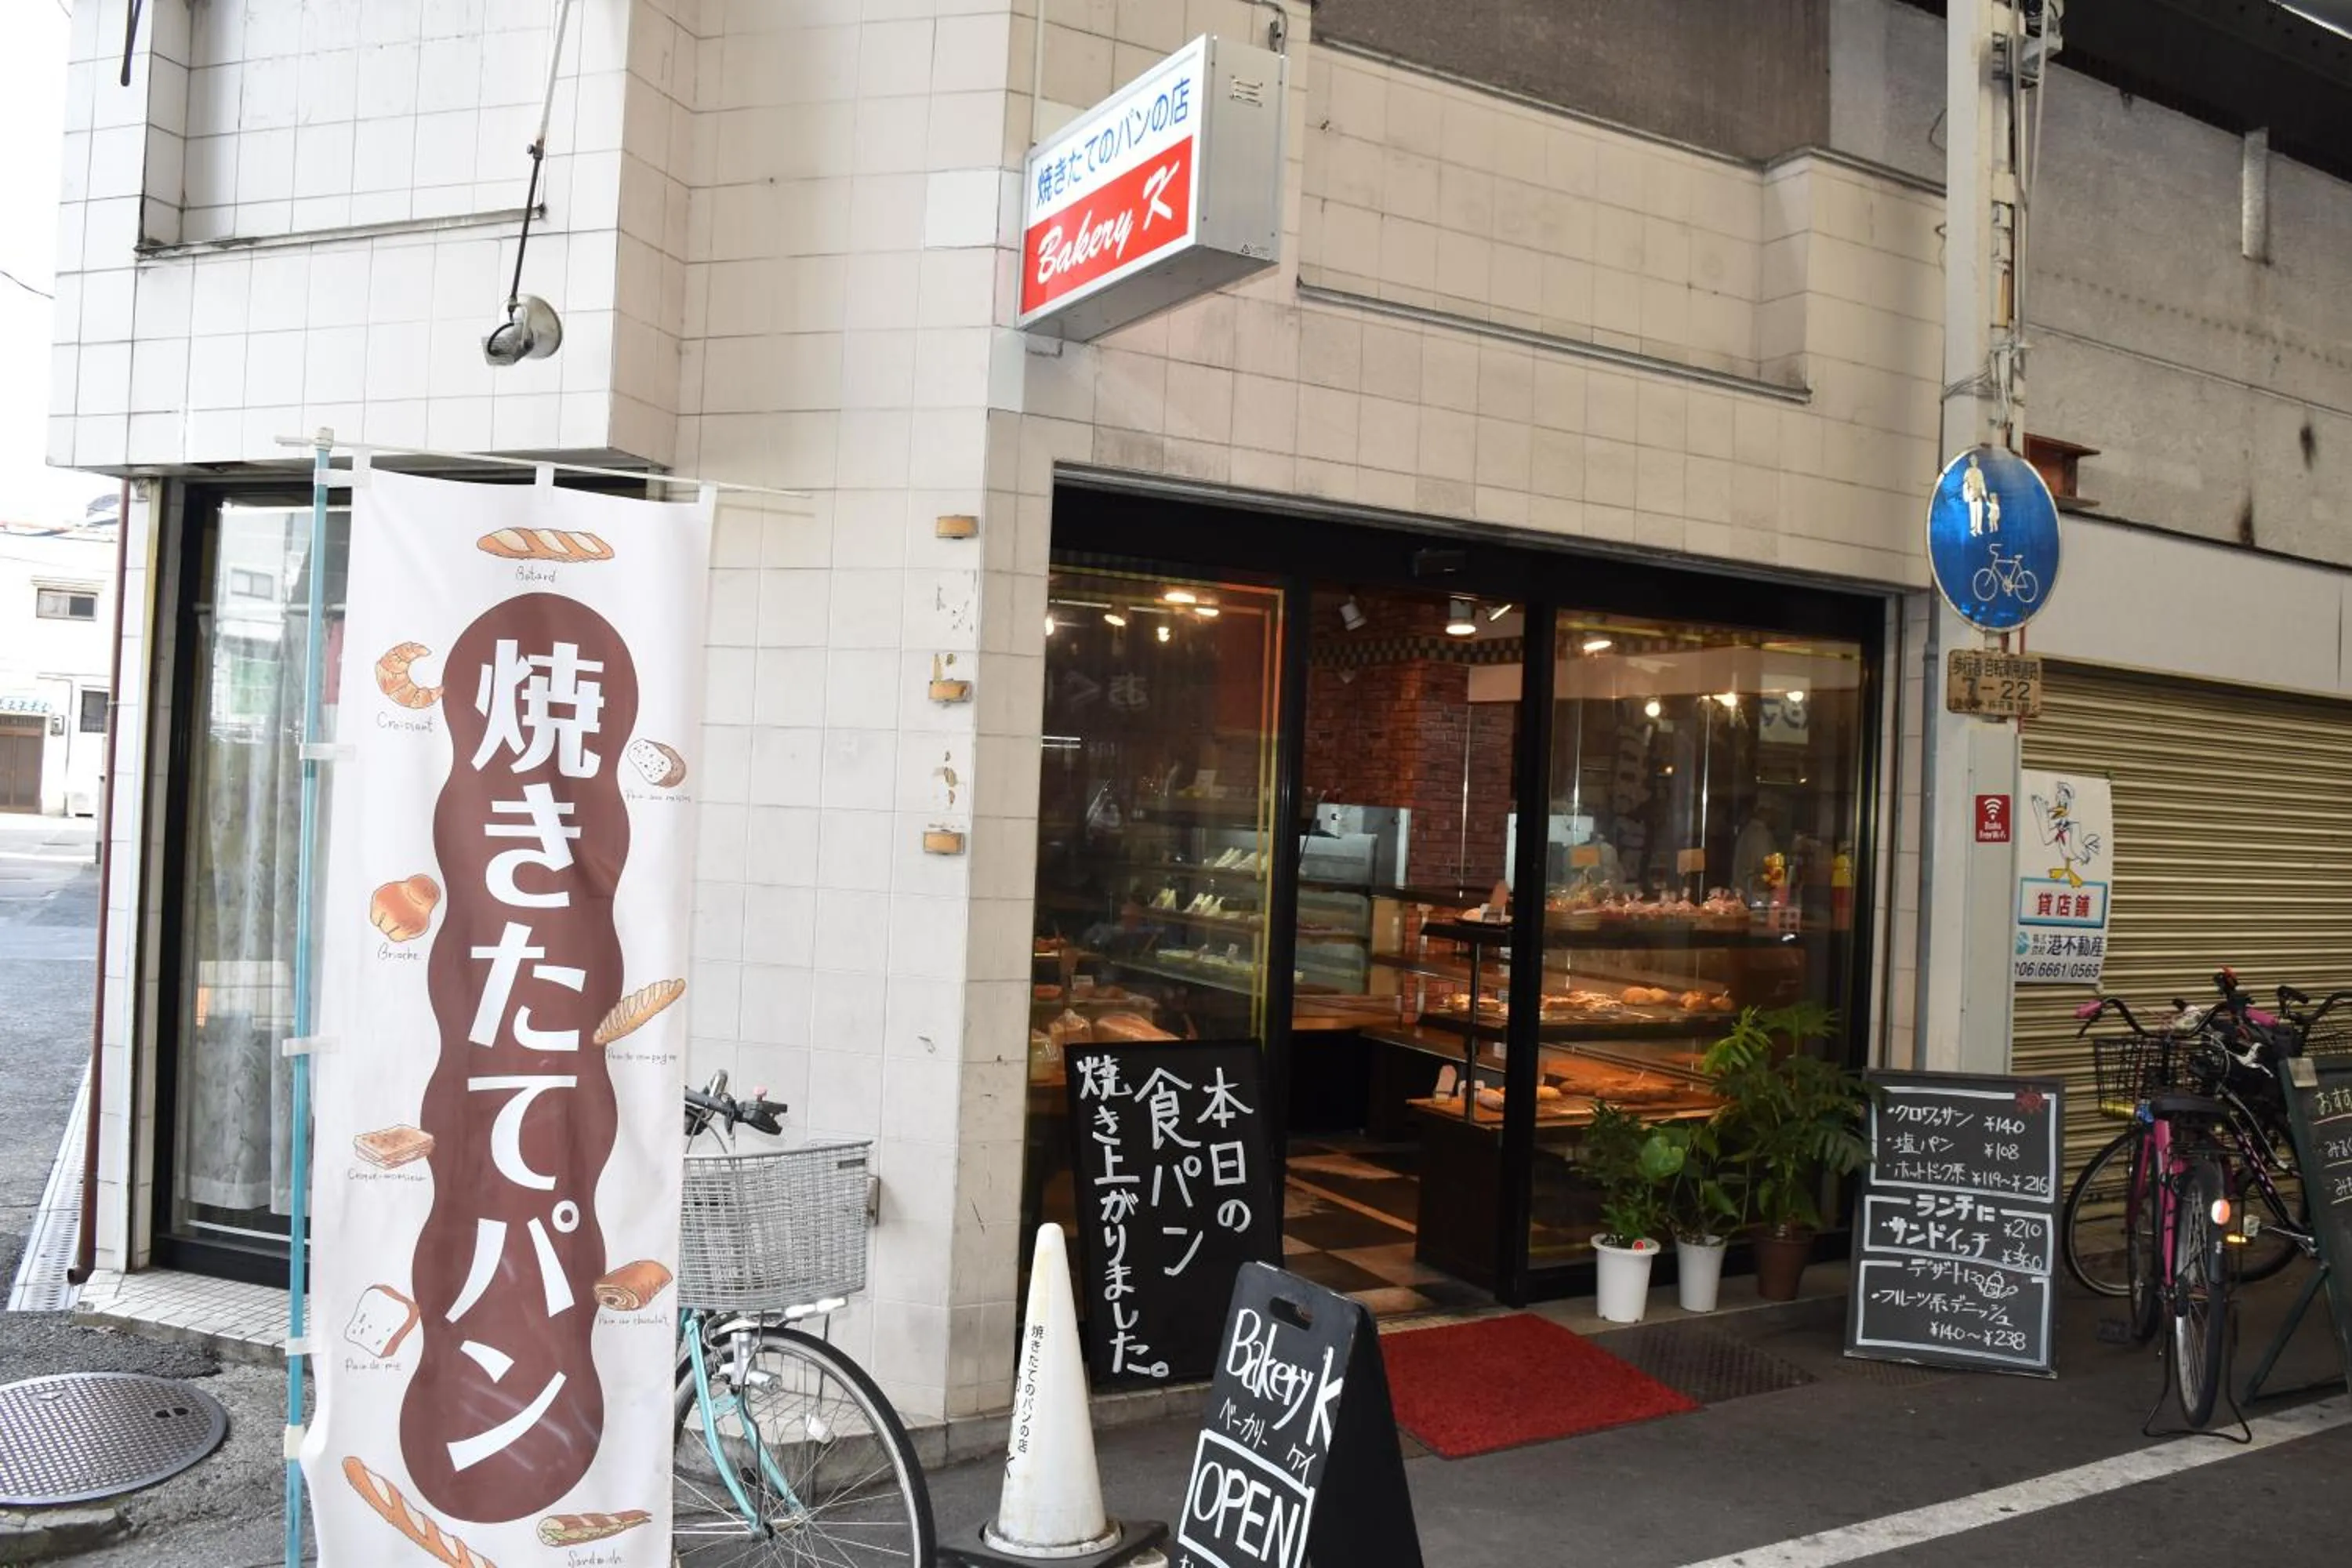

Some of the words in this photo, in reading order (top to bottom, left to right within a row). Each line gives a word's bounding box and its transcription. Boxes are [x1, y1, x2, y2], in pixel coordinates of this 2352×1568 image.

[1036, 78, 1191, 209] 焼きたてのパンの店
[1037, 210, 1133, 284] Bakery
[1142, 161, 1179, 230] K
[2037, 893, 2090, 917] 貸店舗
[446, 639, 604, 1472] 焼きたてパン
[1134, 1067, 1203, 1276] 食パン
[1196, 1067, 1254, 1233] 本日の
[1893, 1132, 1955, 1154] 塩パン
[1076, 1054, 1169, 1377] 焼き上がりました。
[1915, 1194, 1995, 1221] ランチに
[1226, 1308, 1313, 1430] Bakery
[1219, 1397, 1268, 1449] ベーカリー
[1287, 1443, 1317, 1486] ケイ
[1193, 1461, 1301, 1568] OPEN
